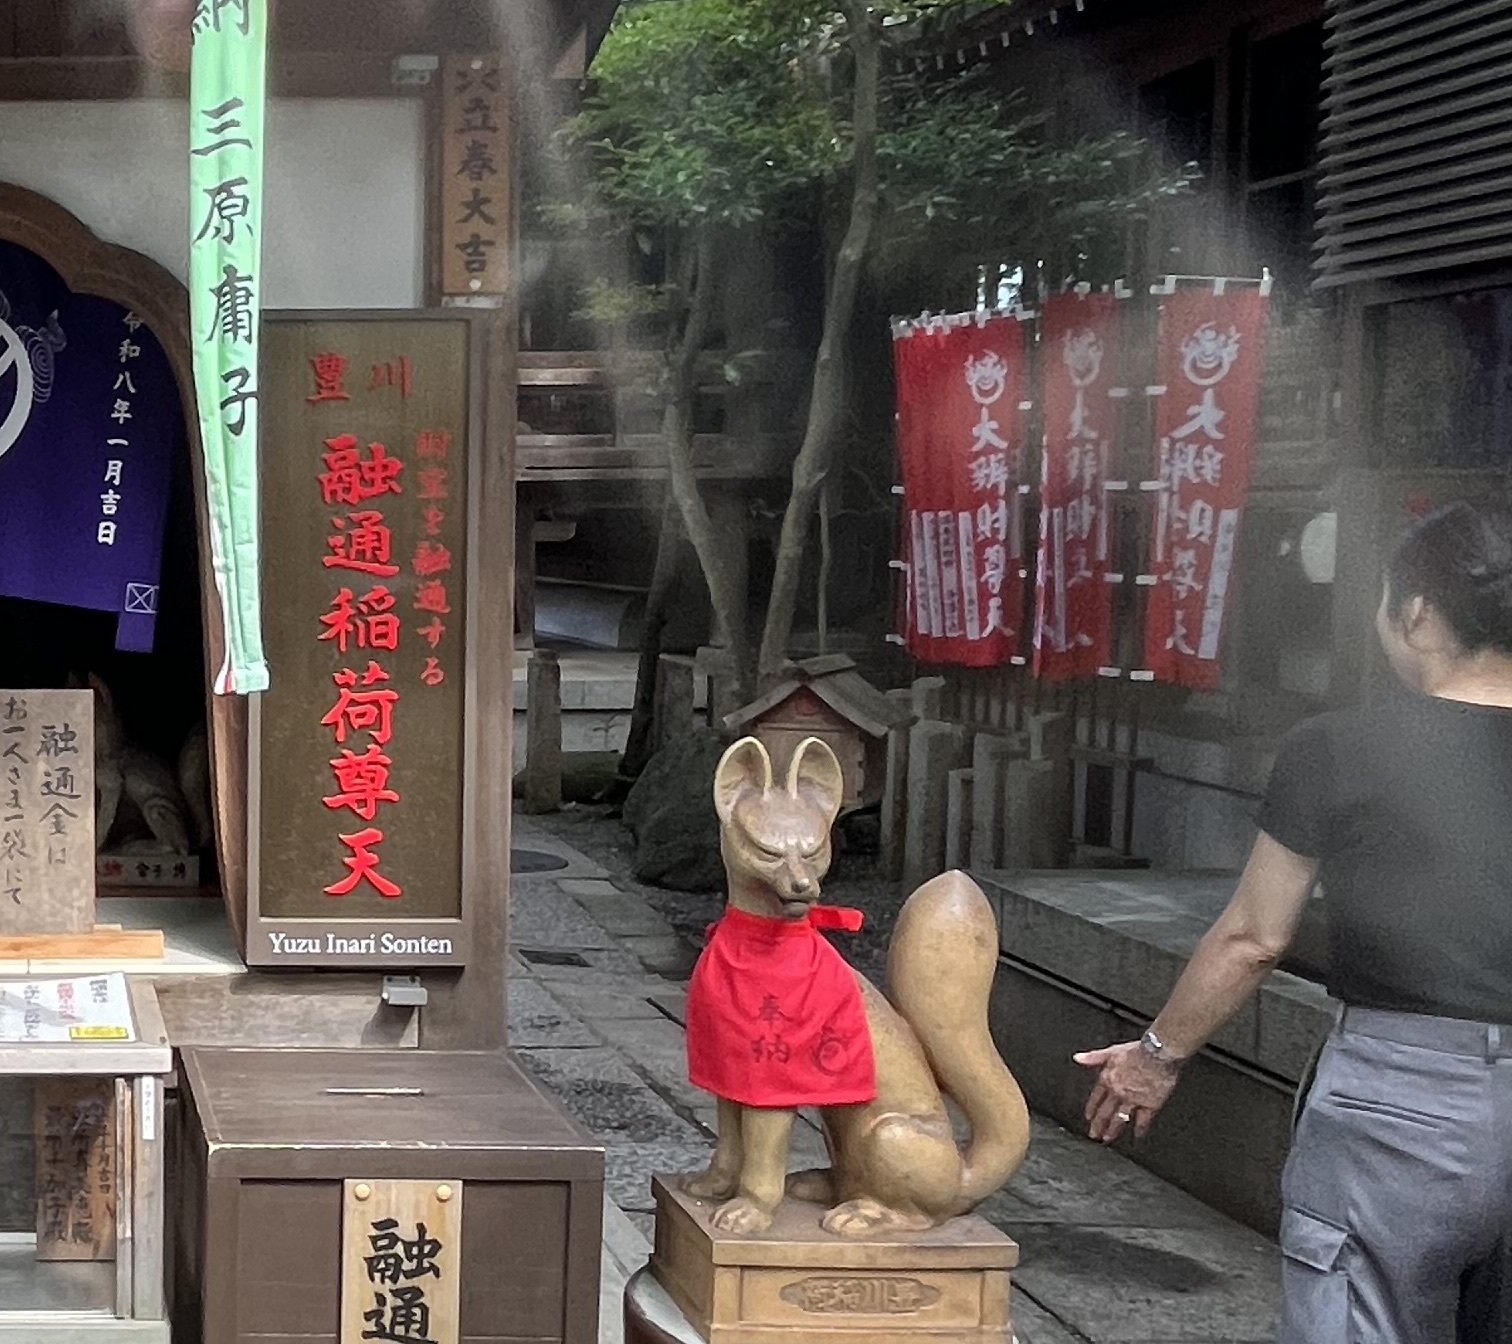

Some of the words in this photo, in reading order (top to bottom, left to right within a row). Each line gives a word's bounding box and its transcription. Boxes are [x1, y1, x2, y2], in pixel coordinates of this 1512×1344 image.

[455, 97, 500, 274] 立春大吉
[96, 311, 143, 545] 令和八年一月吉日
[316, 432, 405, 898] 融通稲荷尊天
[0, 695, 33, 906] お一人さま一袋にて
[36, 722, 82, 865] 融通金は
[268, 932, 322, 955] Yuzu
[326, 932, 376, 954] Inari
[380, 932, 453, 954] Sonten
[749, 993, 795, 1064] 奉納
